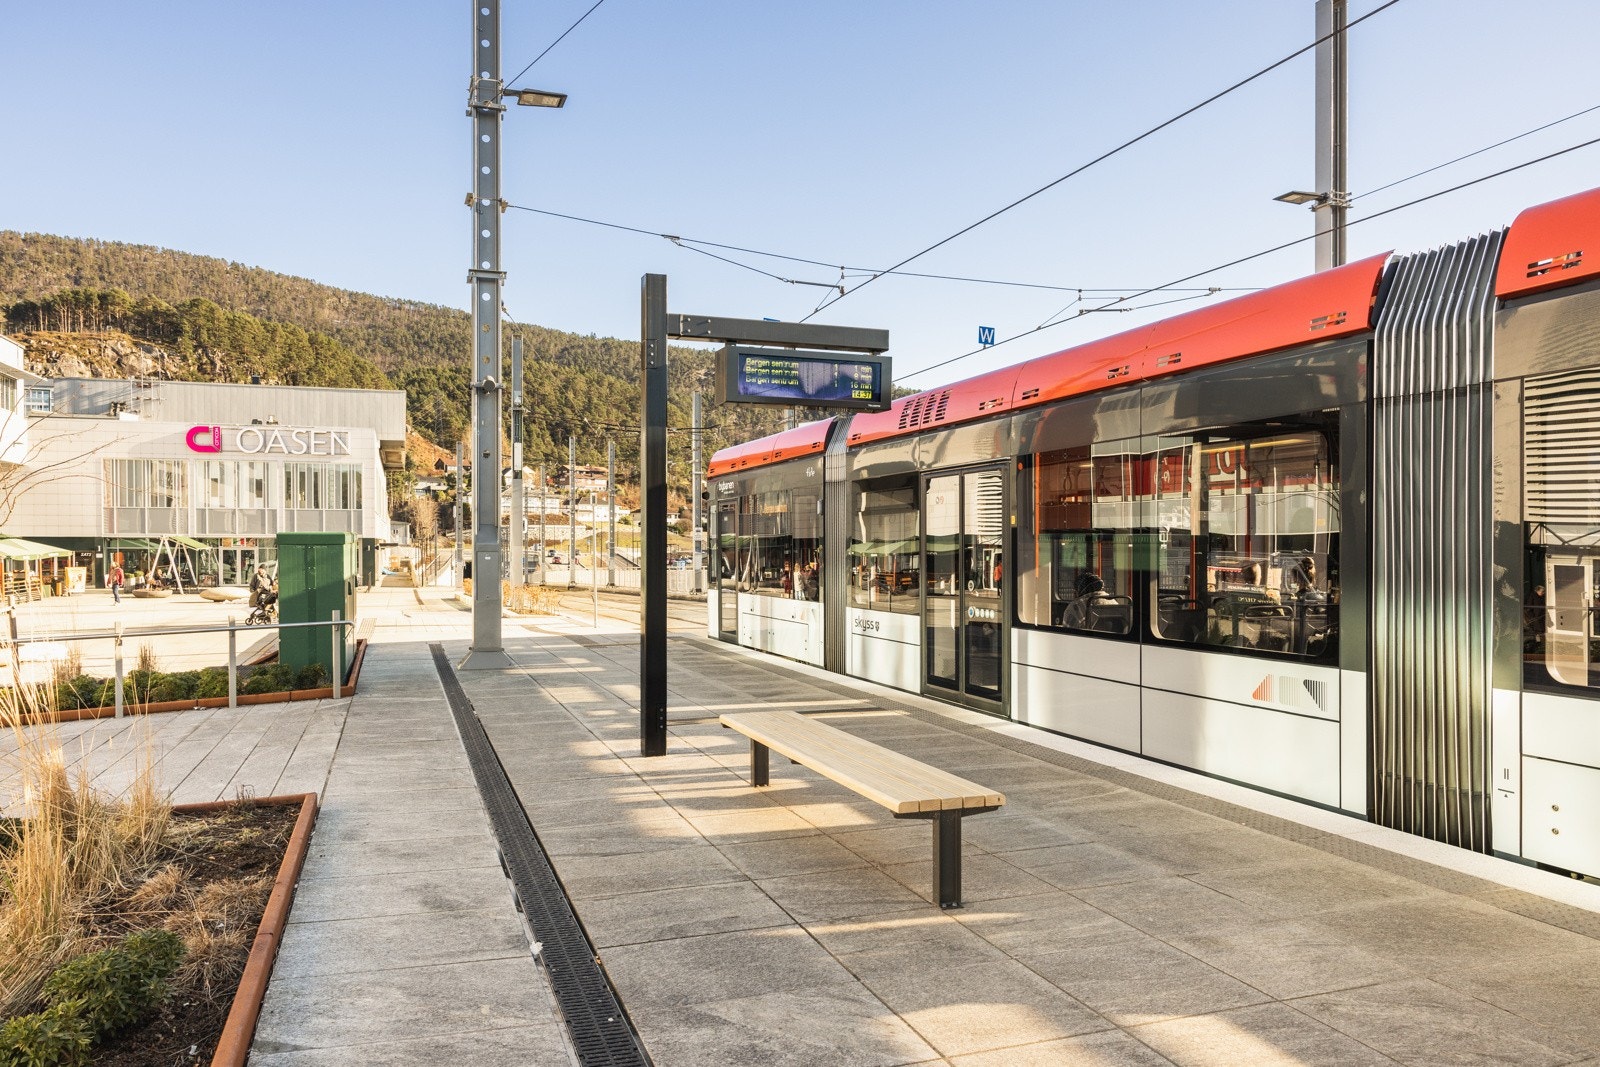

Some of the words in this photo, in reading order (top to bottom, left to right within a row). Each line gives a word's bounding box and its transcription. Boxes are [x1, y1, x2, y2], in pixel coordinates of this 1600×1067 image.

[979, 327, 994, 343] W
[746, 357, 770, 367] Bergen
[746, 366, 770, 376] Bergen
[746, 375, 770, 385] Bergen
[236, 427, 352, 456] OASEN
[854, 615, 875, 632] skyss
